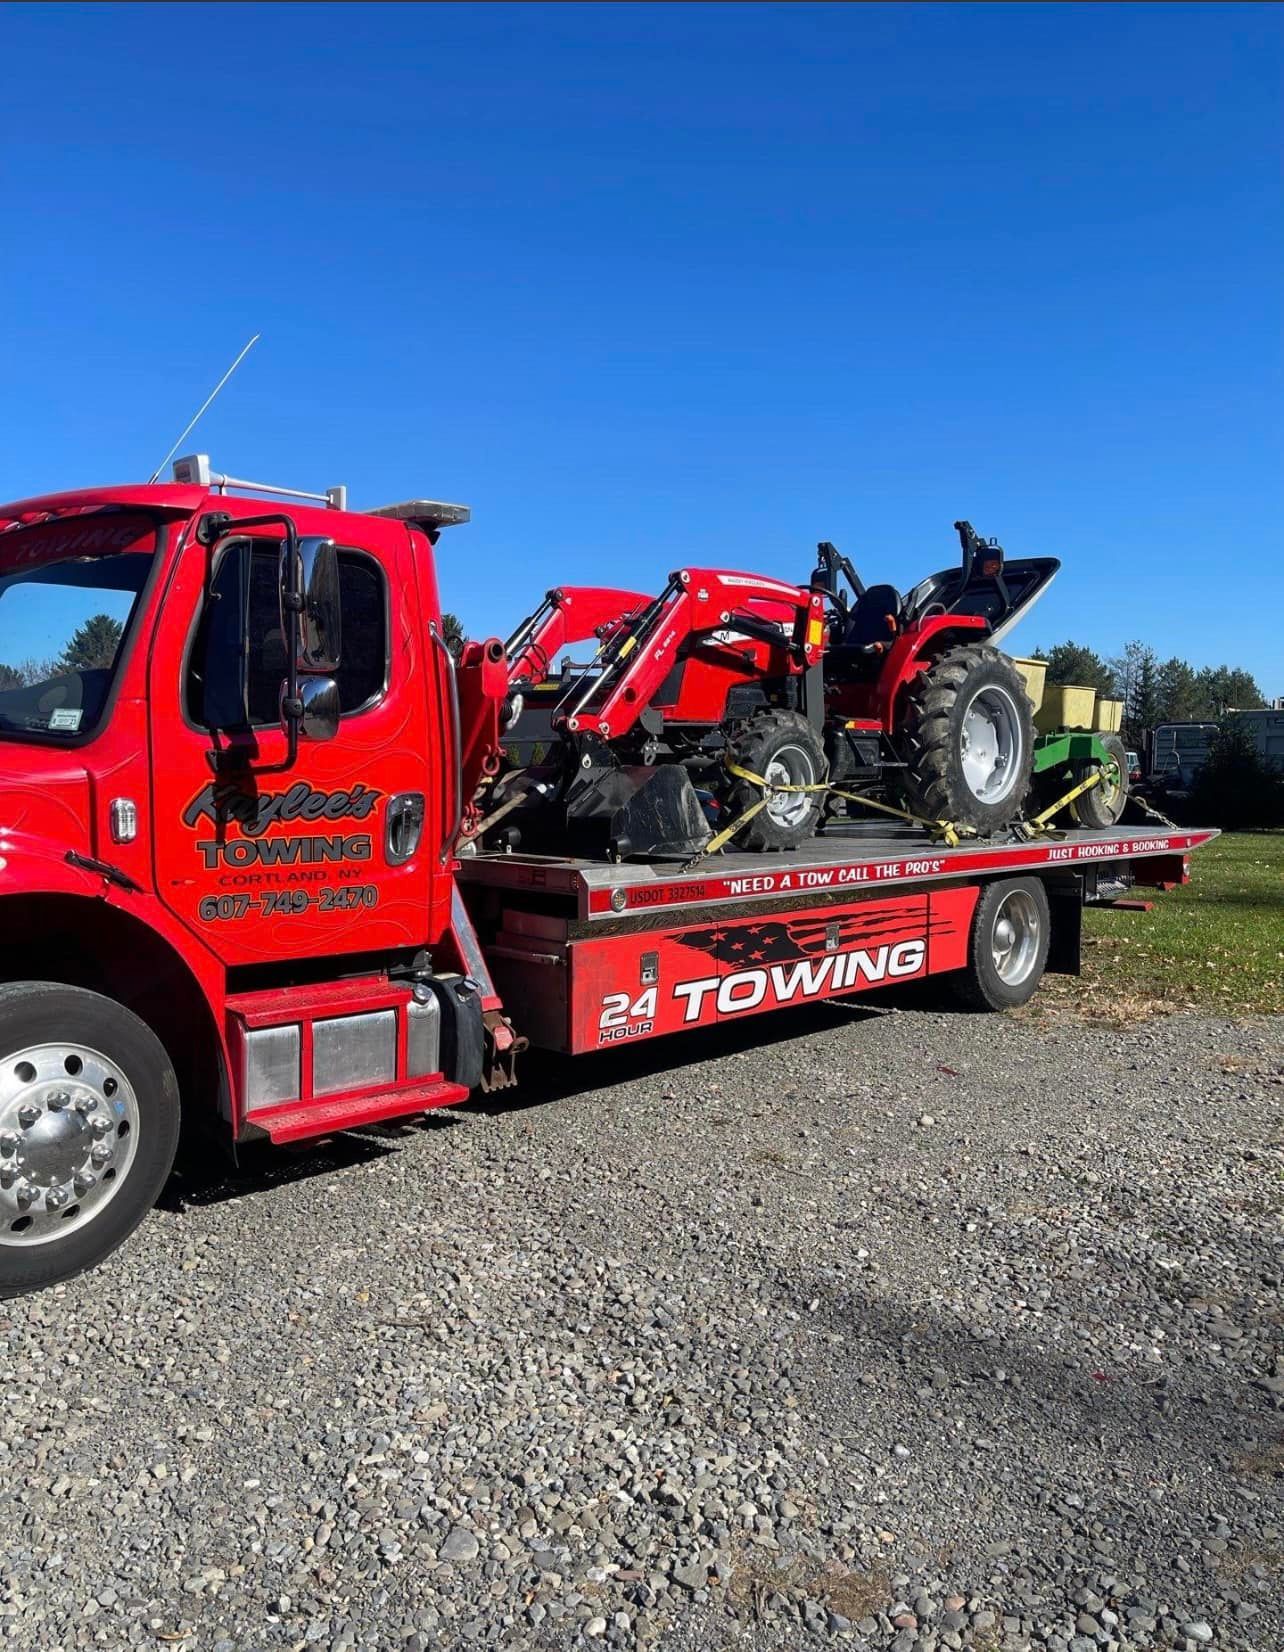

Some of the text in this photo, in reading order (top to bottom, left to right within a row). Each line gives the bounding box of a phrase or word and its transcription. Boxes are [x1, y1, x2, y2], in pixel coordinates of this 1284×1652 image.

[184, 783, 379, 837] Kaylee's
[197, 834, 372, 869] TOWING
[1047, 839, 1169, 860] JUST HOOKING & BOOKING
[338, 869, 361, 879] NY
[723, 860, 945, 894] "NEED A TOW CALL THE PRO'S"
[201, 887, 377, 921] 607-749-2470
[631, 889, 664, 904] USDOT
[599, 938, 928, 1030] 24 TOWING
[599, 1021, 652, 1043] HOUR
